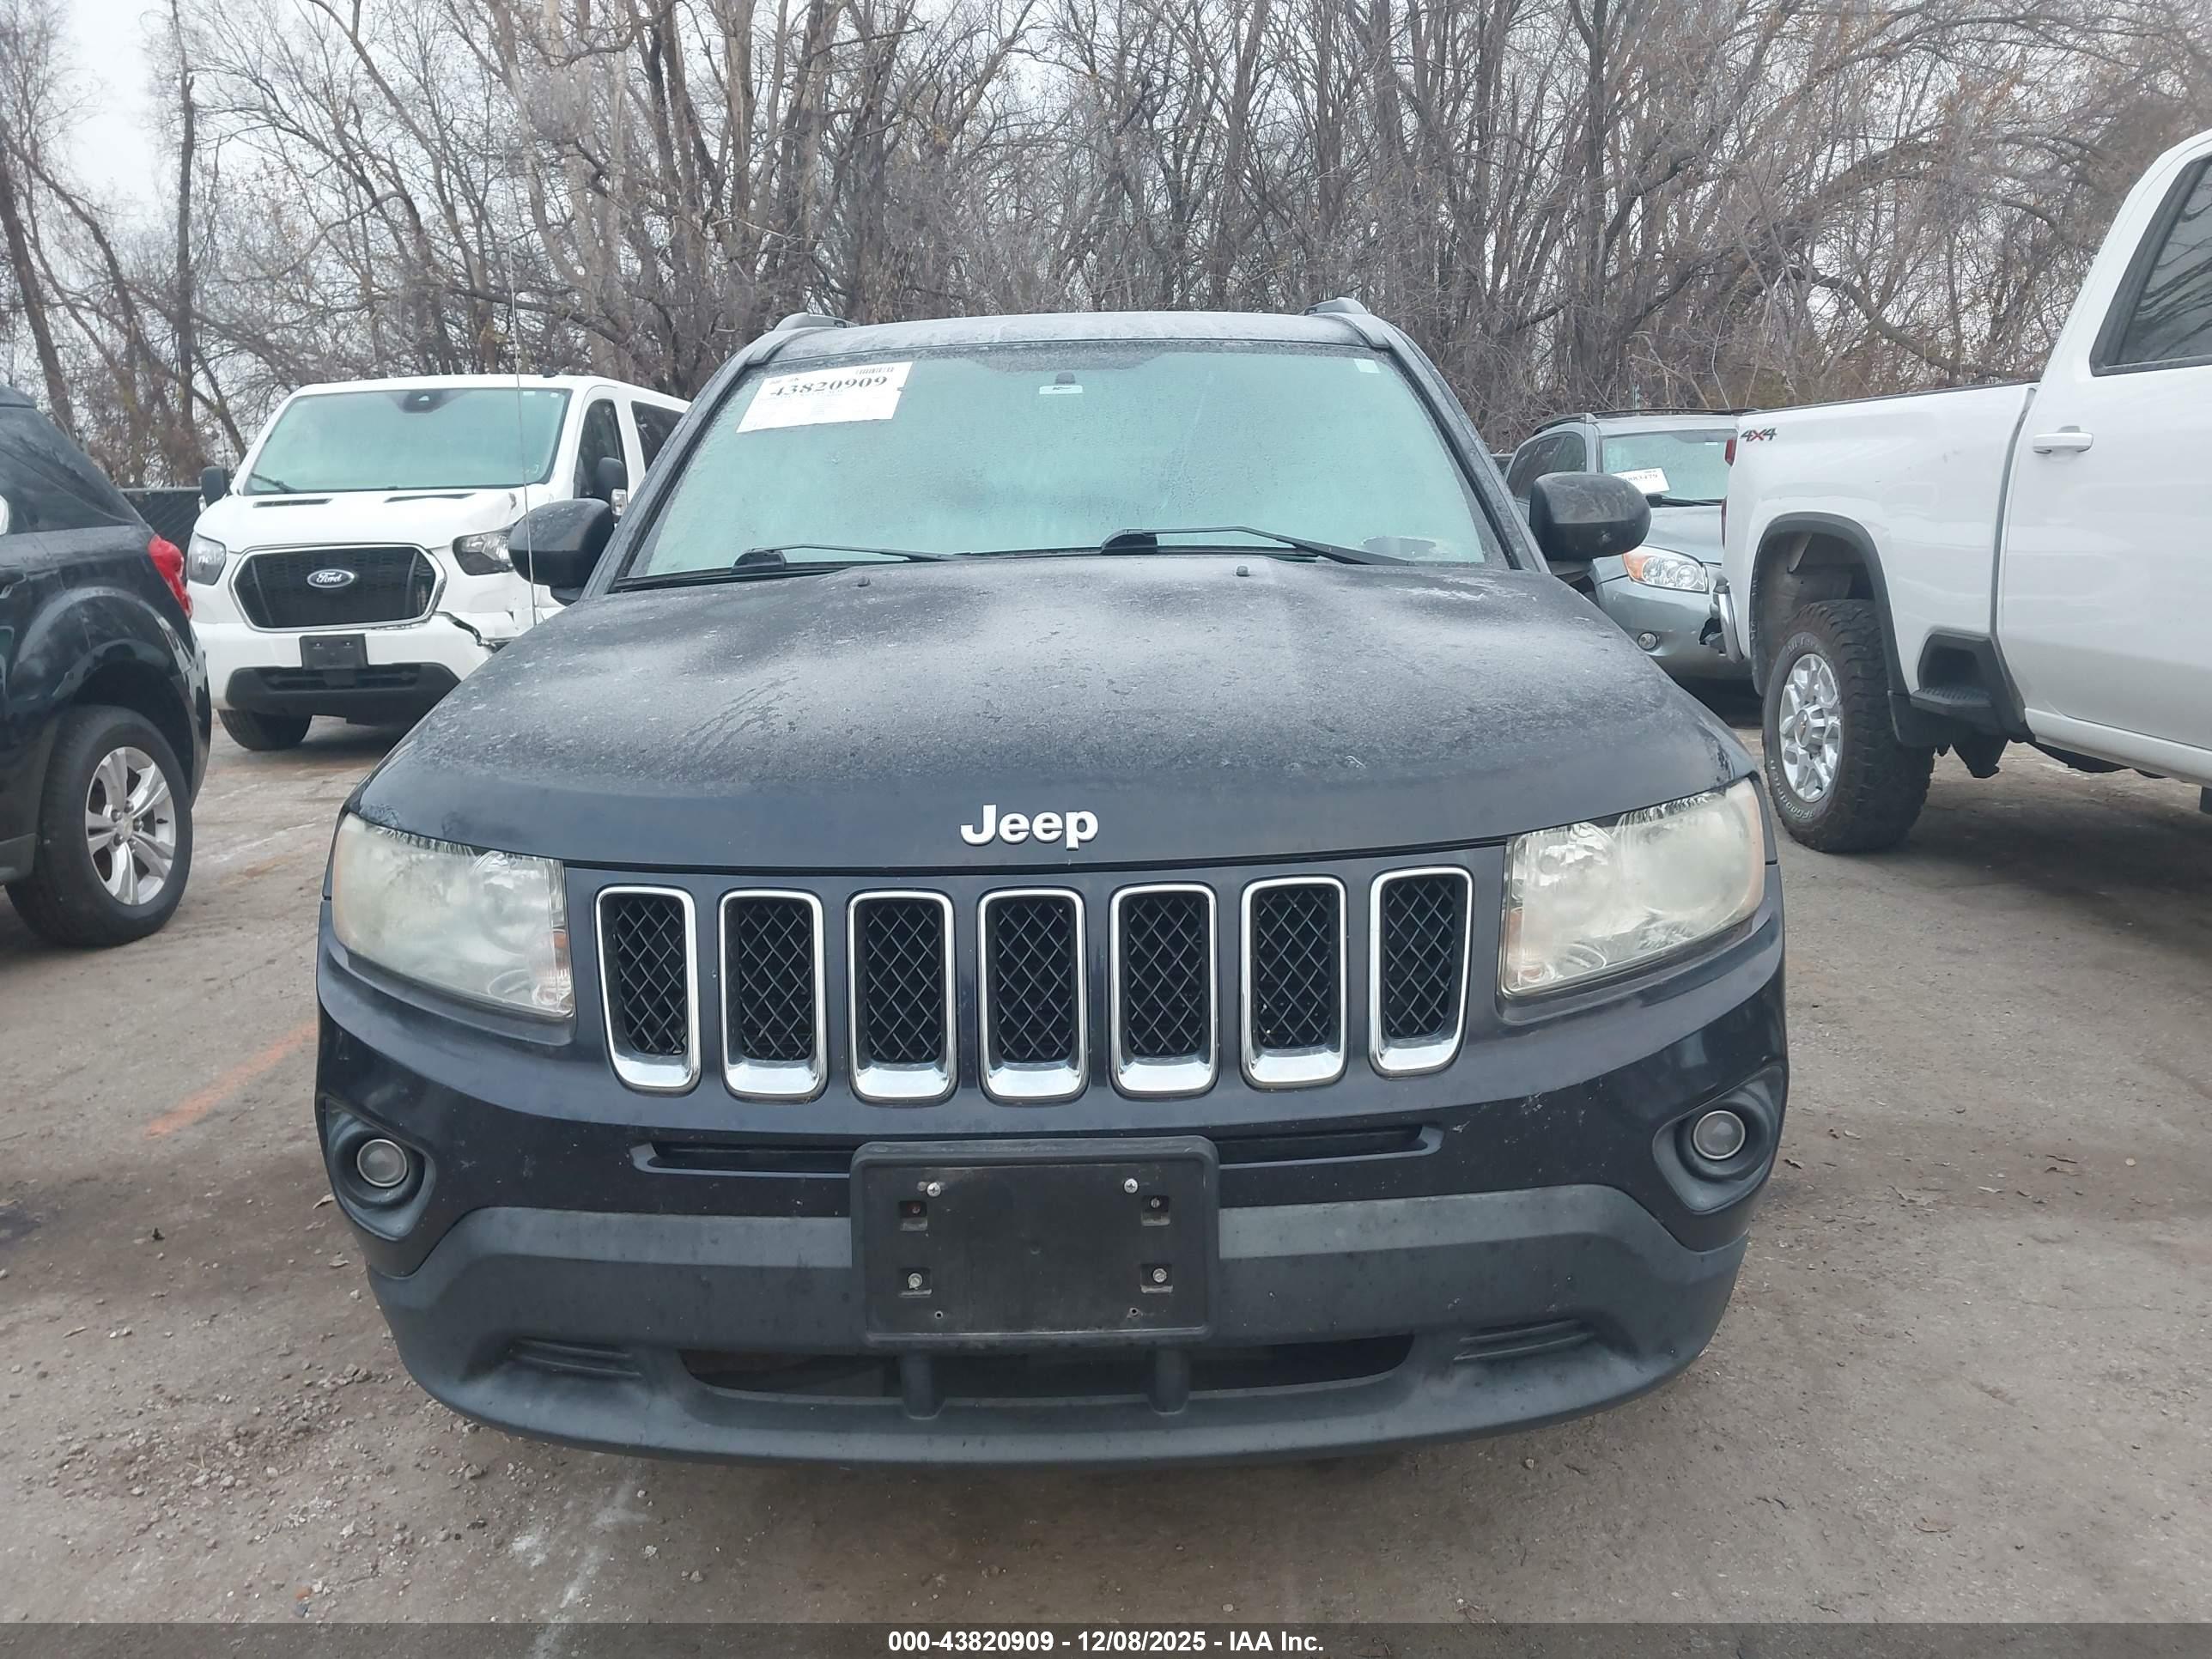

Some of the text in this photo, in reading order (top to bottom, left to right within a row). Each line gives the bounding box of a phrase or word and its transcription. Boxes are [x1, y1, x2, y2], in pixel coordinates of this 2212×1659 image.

[769, 376, 888, 396] 43820909
[316, 571, 343, 583] Ford
[960, 804, 1099, 851] Jeep
